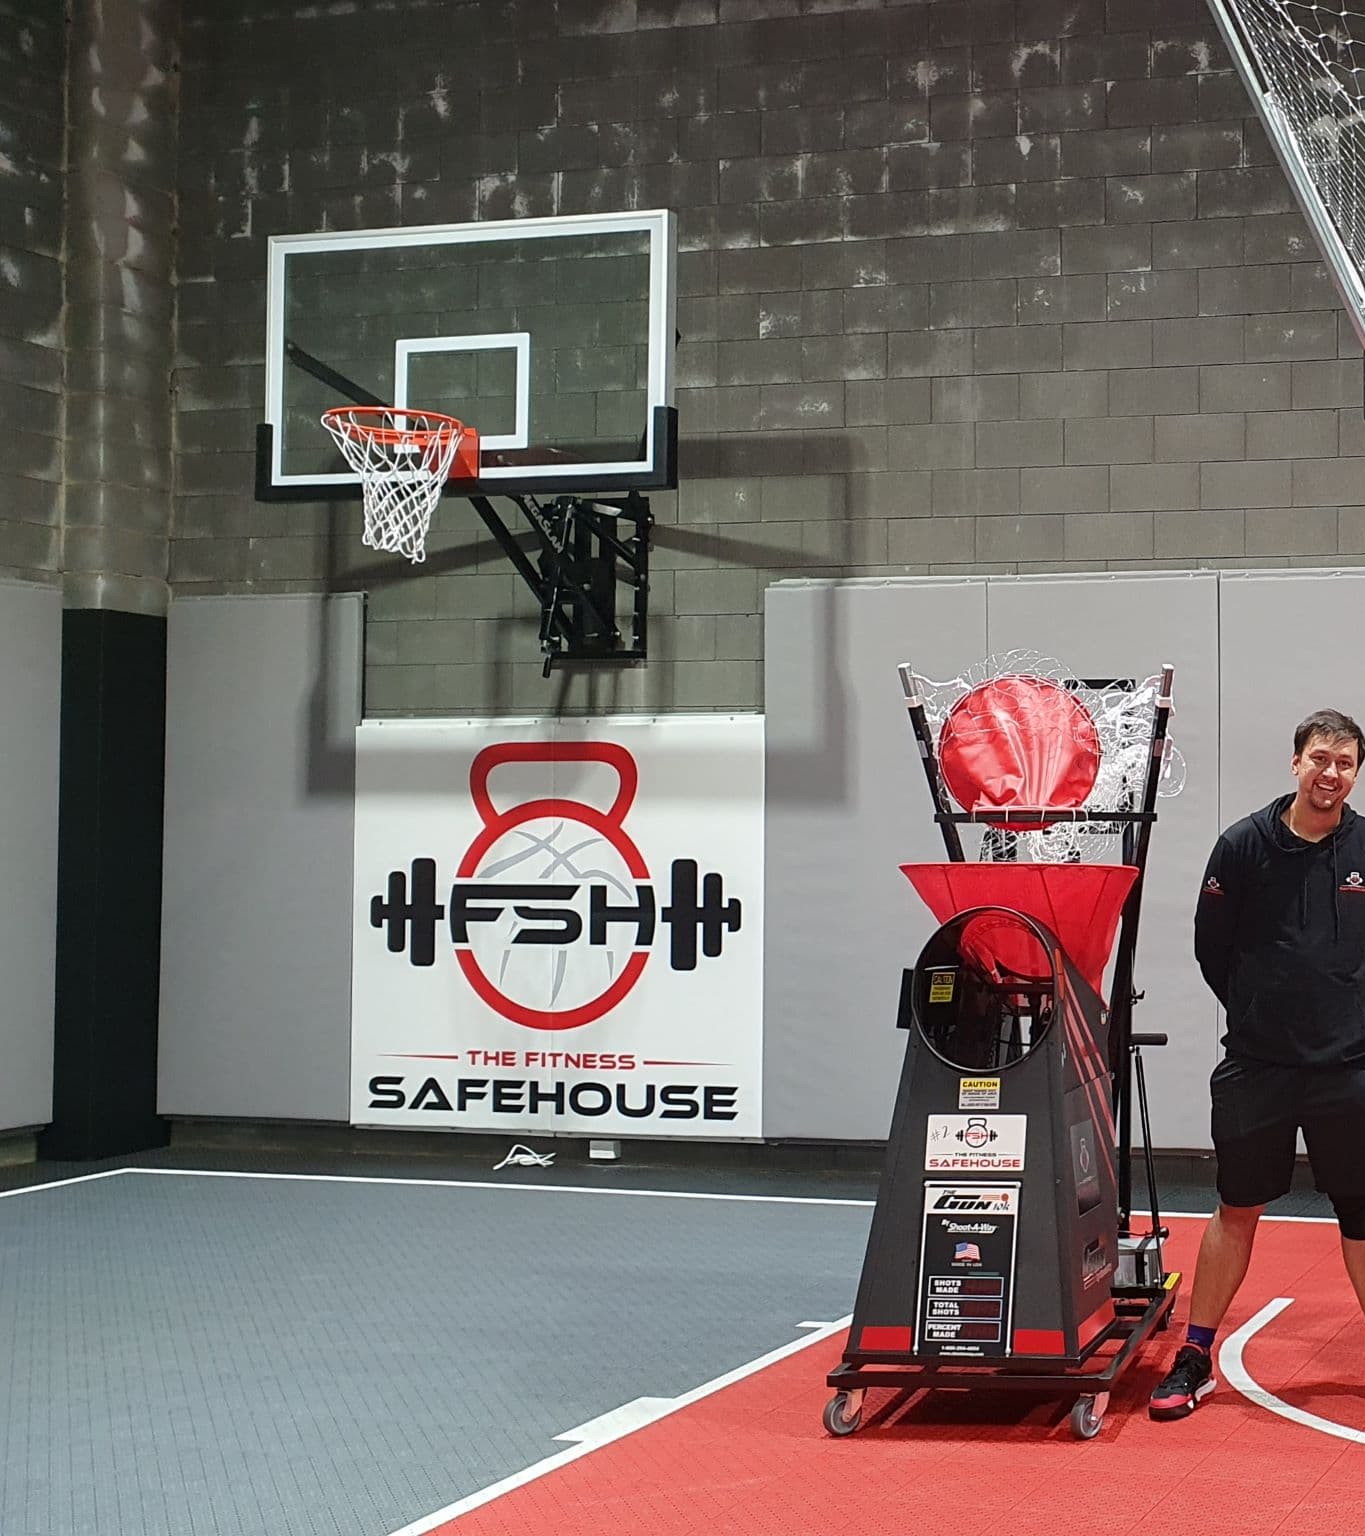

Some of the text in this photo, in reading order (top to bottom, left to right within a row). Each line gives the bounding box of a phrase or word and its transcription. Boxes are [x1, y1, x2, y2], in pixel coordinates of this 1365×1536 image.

[450, 884, 656, 946] FSH
[467, 1050, 636, 1070] THE FITNESS
[368, 1076, 739, 1120] SAFEHOUSE
[929, 1159, 1021, 1168] SAFEHOUSE
[928, 1323, 962, 1331] PERCENT
